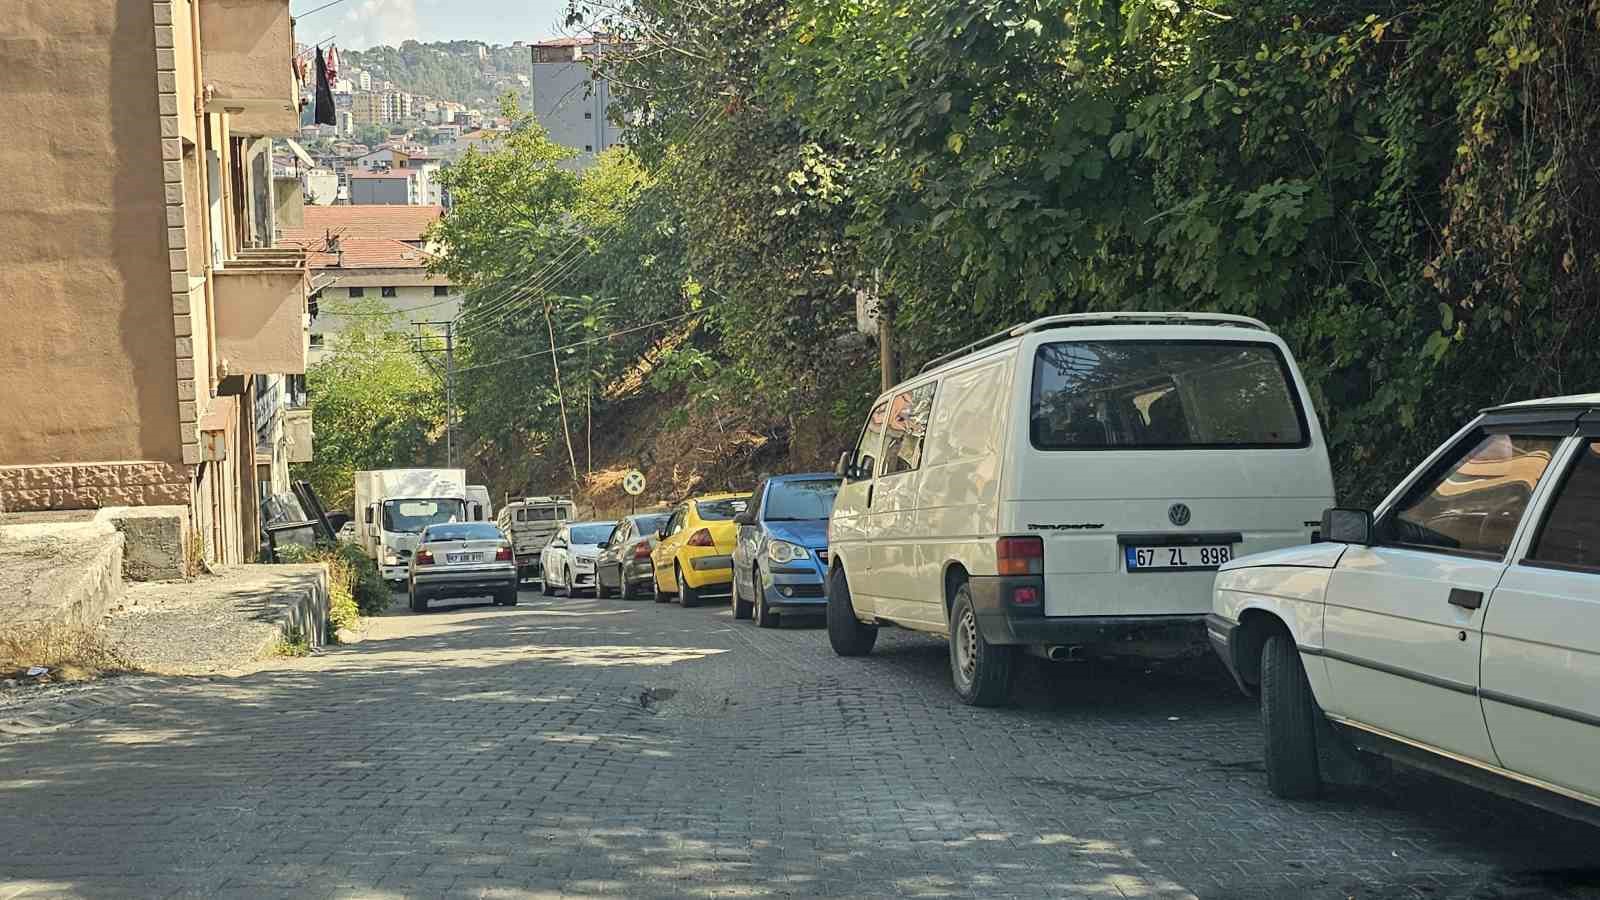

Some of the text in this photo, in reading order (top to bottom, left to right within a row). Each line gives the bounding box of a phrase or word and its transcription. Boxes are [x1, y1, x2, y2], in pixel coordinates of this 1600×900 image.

[1136, 549, 1154, 566] 67
[1168, 548, 1188, 566] ZL
[1200, 547, 1228, 564] 898
